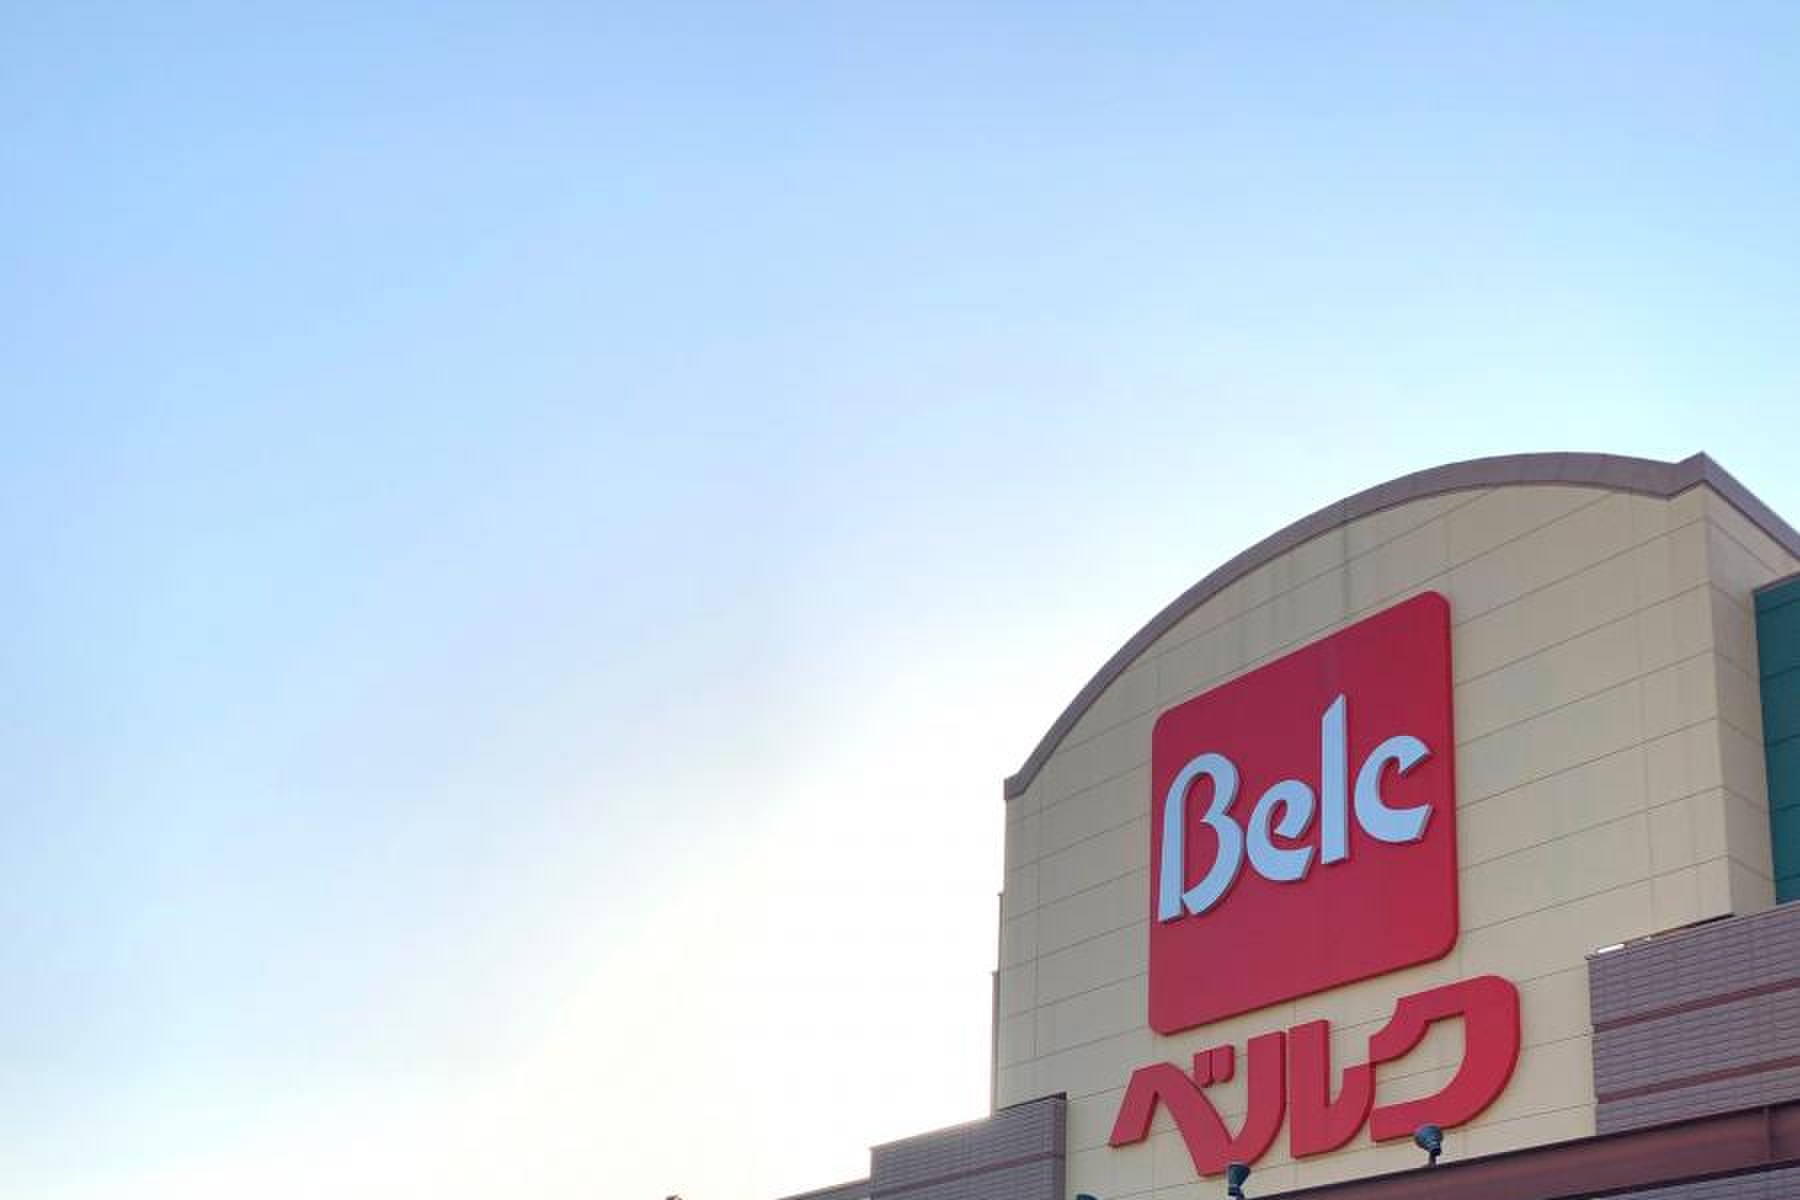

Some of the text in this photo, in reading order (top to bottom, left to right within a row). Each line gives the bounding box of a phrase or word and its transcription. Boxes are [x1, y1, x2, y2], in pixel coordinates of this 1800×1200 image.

[1157, 693, 1431, 923] Belc
[1108, 974, 1521, 1178] ベルク
